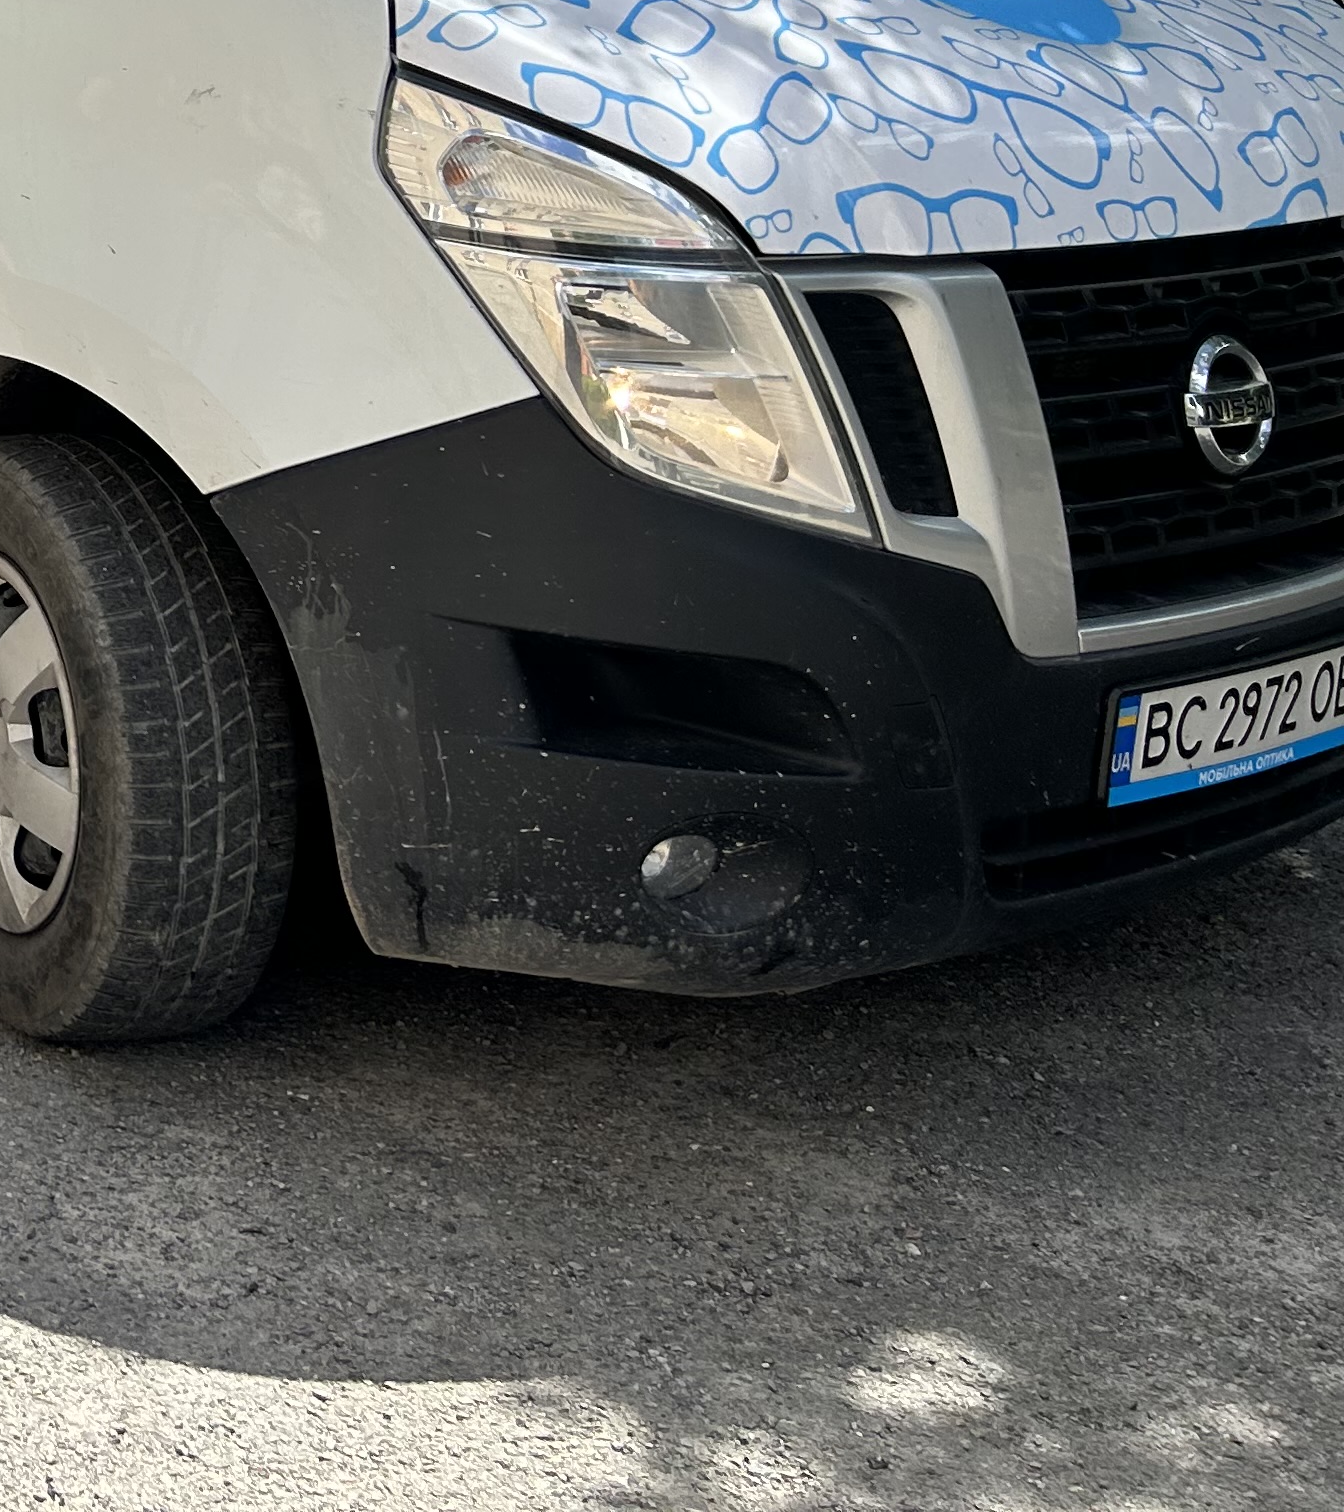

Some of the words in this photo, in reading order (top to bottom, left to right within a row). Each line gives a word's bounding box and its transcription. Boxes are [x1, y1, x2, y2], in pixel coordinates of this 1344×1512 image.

[1141, 695, 1207, 769] BC
[1213, 670, 1302, 753] 2972
[1112, 751, 1130, 773] UA
[1198, 759, 1254, 786] МОБІЛЬНА
[1255, 746, 1295, 770] ОПТИКА
